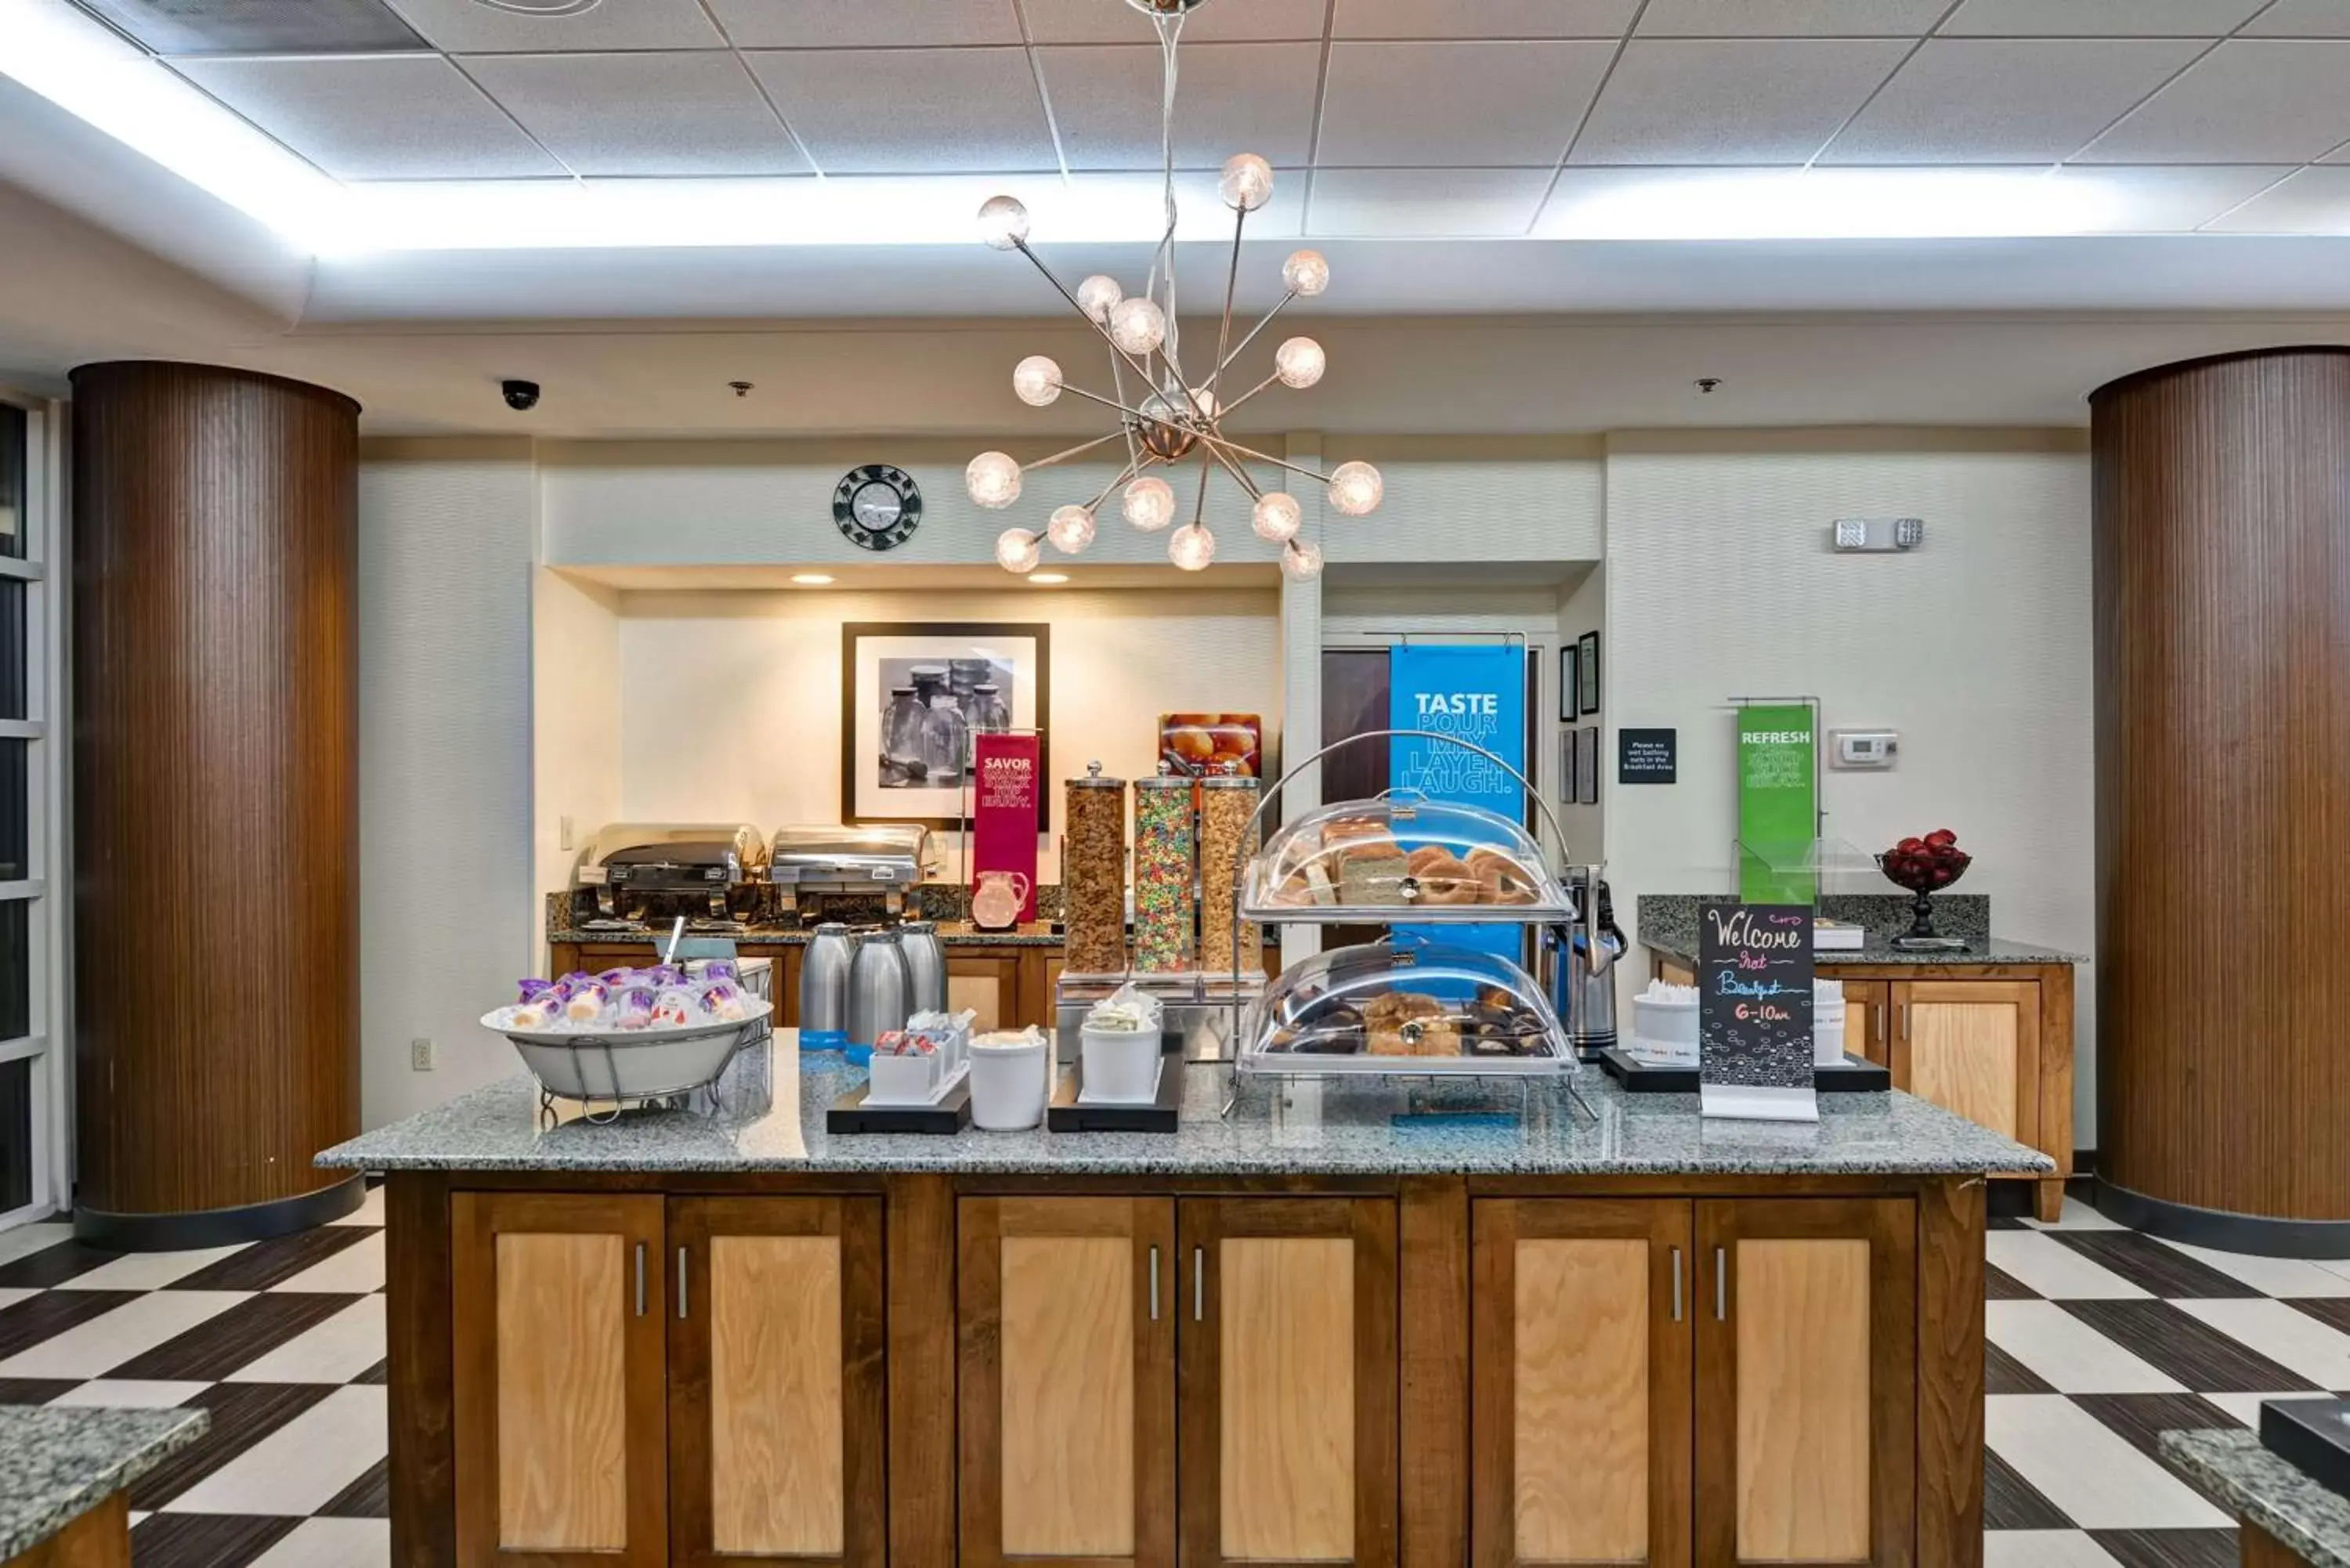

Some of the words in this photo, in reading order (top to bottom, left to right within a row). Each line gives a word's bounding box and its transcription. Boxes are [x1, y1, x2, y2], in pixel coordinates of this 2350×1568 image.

[1415, 693, 1498, 714] TASTE
[1416, 714, 1498, 734] POUR
[1426, 732, 1486, 754] MIX
[1741, 731, 1810, 744] REFRESH
[984, 757, 1031, 769] SAVOR
[1410, 751, 1503, 773] LAYER
[1643, 748, 1669, 757] bathing
[1401, 770, 1513, 793] LAUGH.
[1708, 909, 1802, 949] Welcome
